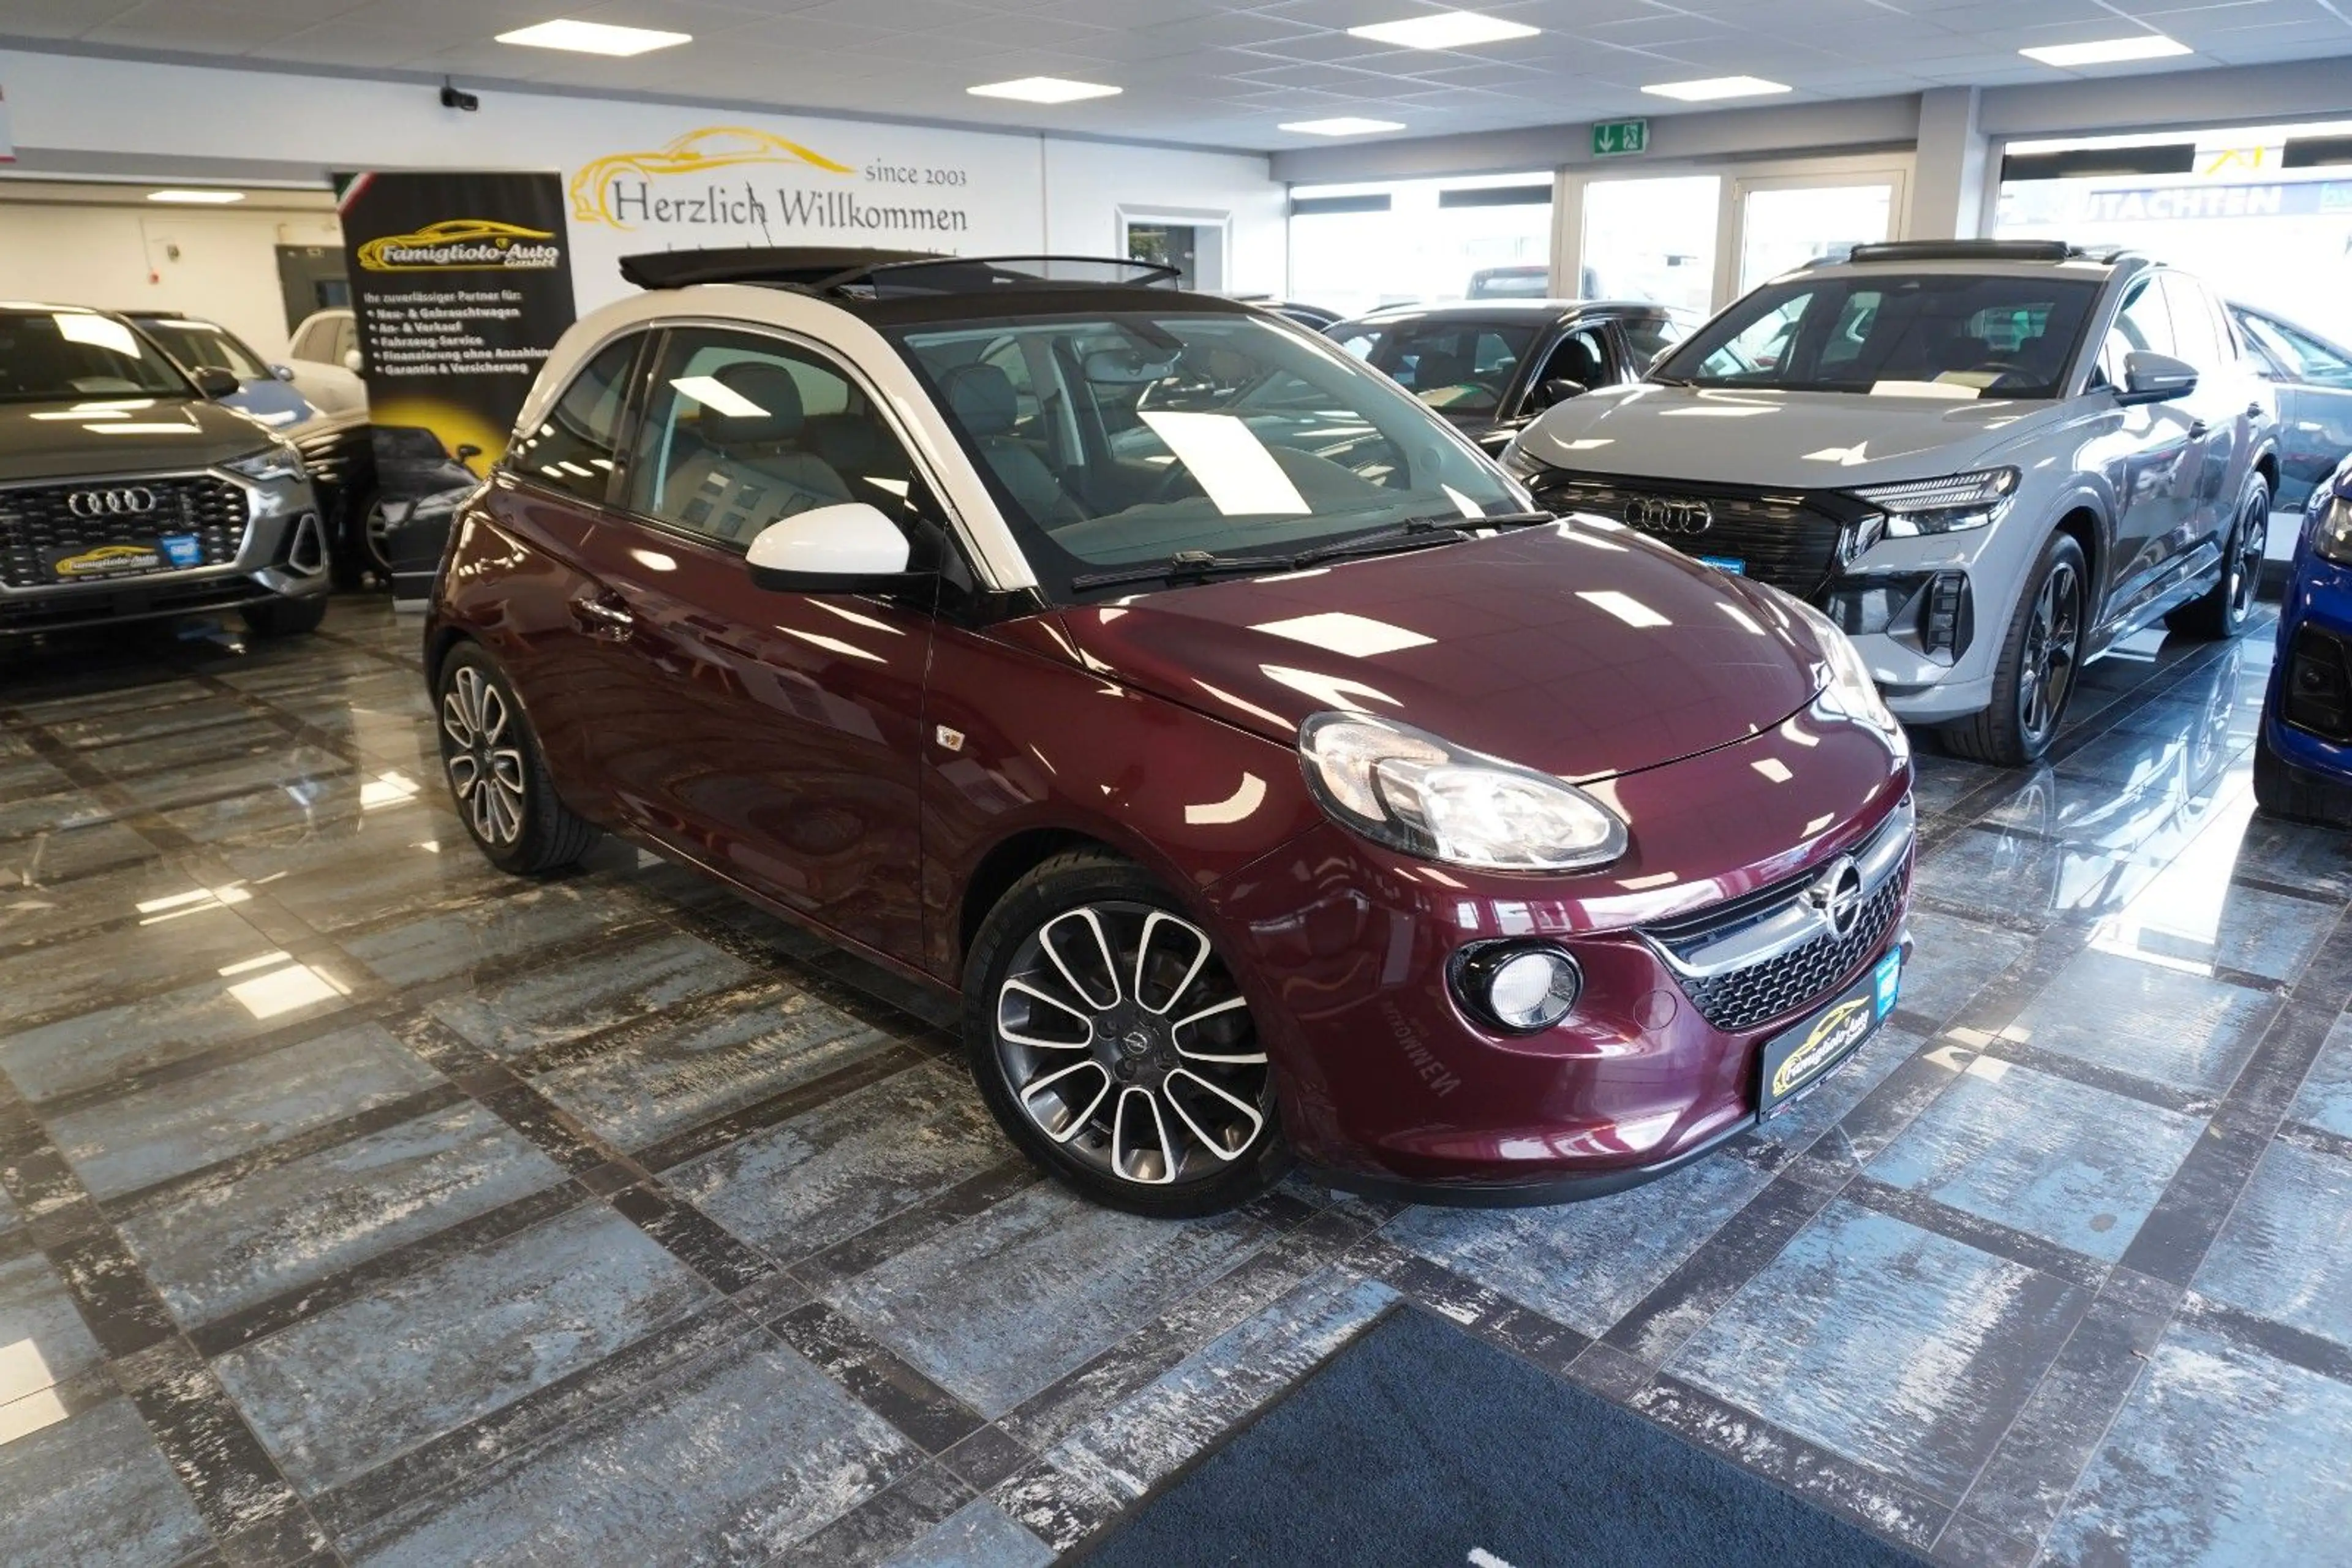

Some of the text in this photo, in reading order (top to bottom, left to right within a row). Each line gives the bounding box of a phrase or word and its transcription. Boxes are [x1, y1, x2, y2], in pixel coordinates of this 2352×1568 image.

[865, 157, 967, 186] since 2003
[612, 181, 967, 231] Herzlich Willkommen
[364, 289, 522, 304] Ihr zuverlässiger Partner für:
[376, 307, 521, 320] Neu- & Gebrauchtwagen
[379, 320, 462, 333] An- & Verkauf
[380, 336, 484, 349] Fahrzeug-Service
[382, 350, 461, 362] Finanzierung
[463, 348, 493, 360] ohne
[385, 362, 529, 375] Garantie & Versicherung
